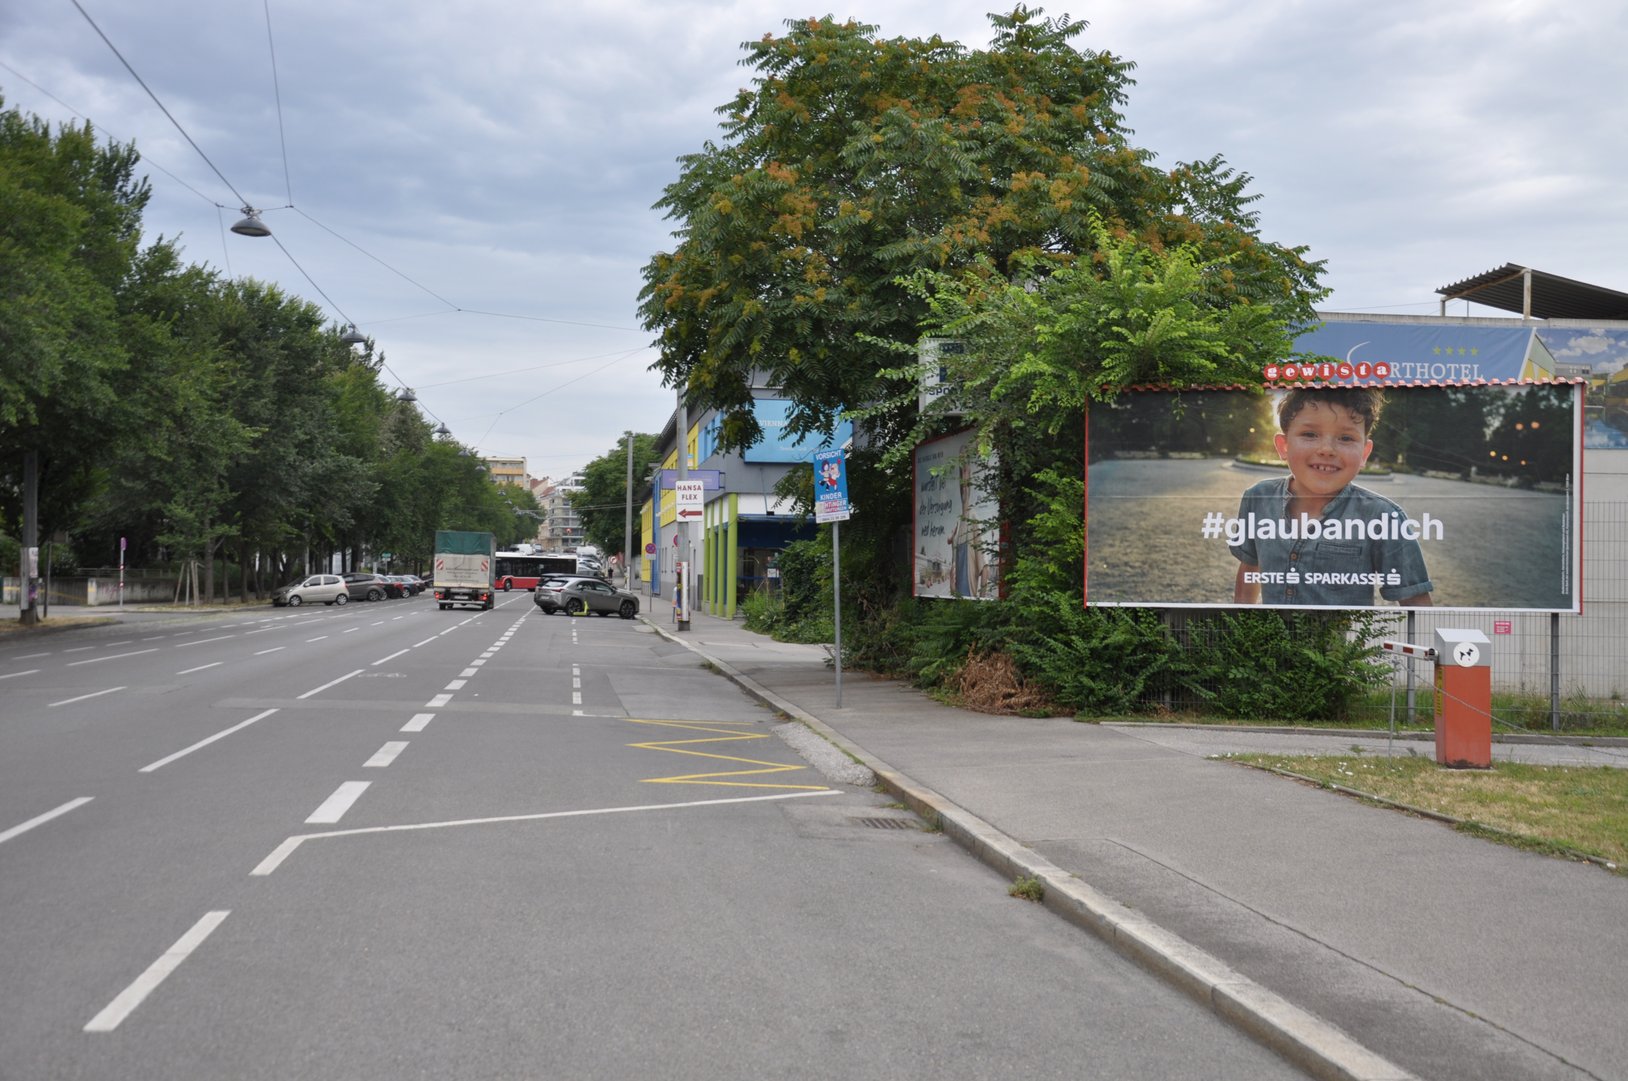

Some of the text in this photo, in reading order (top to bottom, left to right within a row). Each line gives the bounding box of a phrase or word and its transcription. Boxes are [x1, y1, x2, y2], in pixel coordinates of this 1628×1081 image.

[1267, 363, 1389, 379] gewista
[815, 449, 842, 461] VORSICHT
[682, 493, 698, 501] FLEX
[819, 491, 842, 501] KINDER
[1201, 511, 1444, 547] #glaubandich
[1244, 571, 1385, 585] ERSTE SPARKASSE
